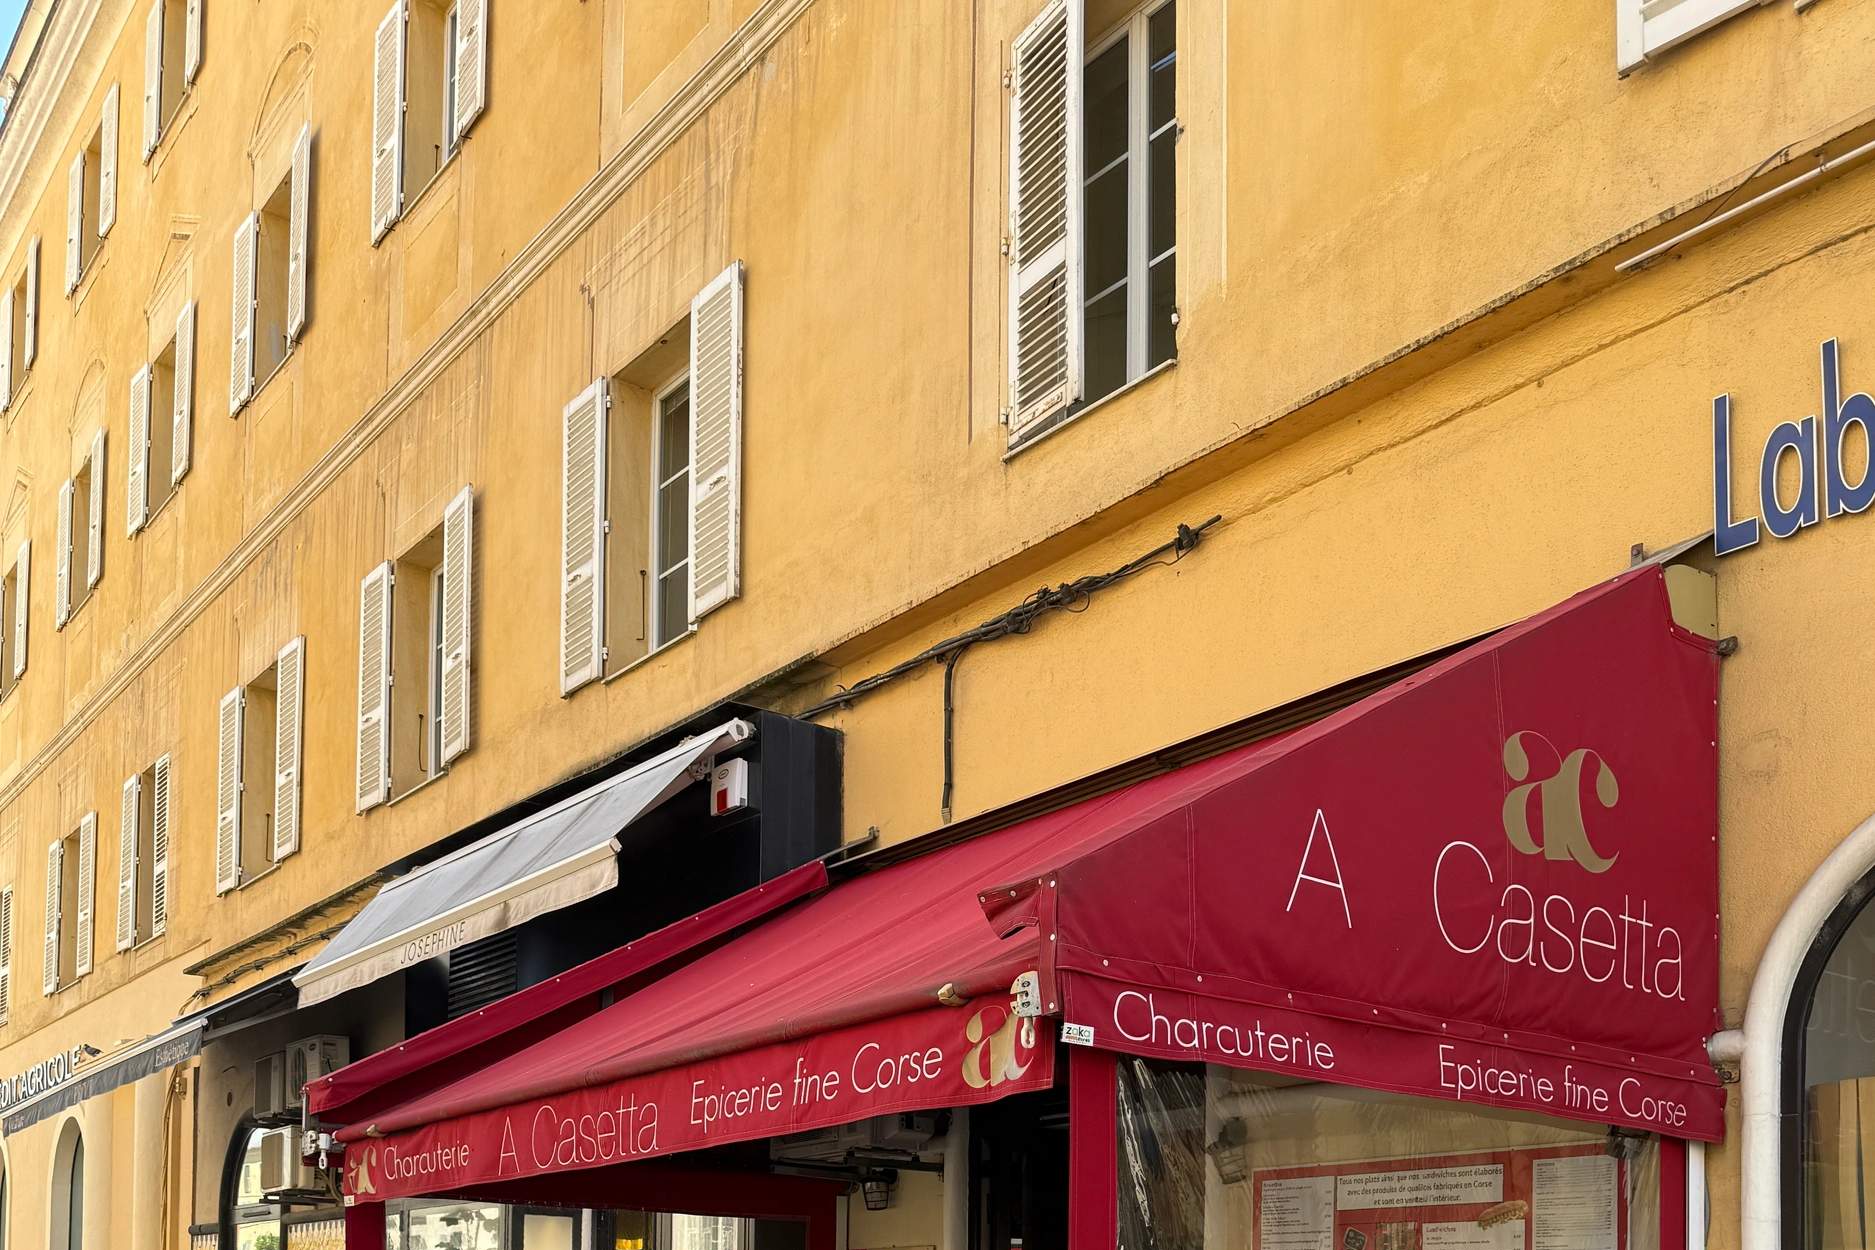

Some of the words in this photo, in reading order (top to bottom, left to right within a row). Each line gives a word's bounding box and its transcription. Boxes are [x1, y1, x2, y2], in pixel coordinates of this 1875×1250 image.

[1713, 336, 1875, 556] Lab
[400, 921, 466, 964] JOSEPHINE
[1286, 808, 1352, 929] A
[1433, 840, 1687, 1001] Casetta
[1112, 990, 1336, 1070] Charcuterie
[0, 1076, 20, 1109] DIT
[20, 1045, 83, 1101] AGRICOLE
[384, 1141, 470, 1181] Charcuterie
[498, 1115, 520, 1176] A
[531, 1092, 659, 1169] Casetta
[690, 1079, 783, 1134] Epicerie
[792, 1057, 840, 1107] fine
[851, 1042, 944, 1094] Corse
[1438, 1043, 1555, 1100] Epicerie
[1563, 1064, 1609, 1113] fine
[1618, 1078, 1688, 1128] Corse
